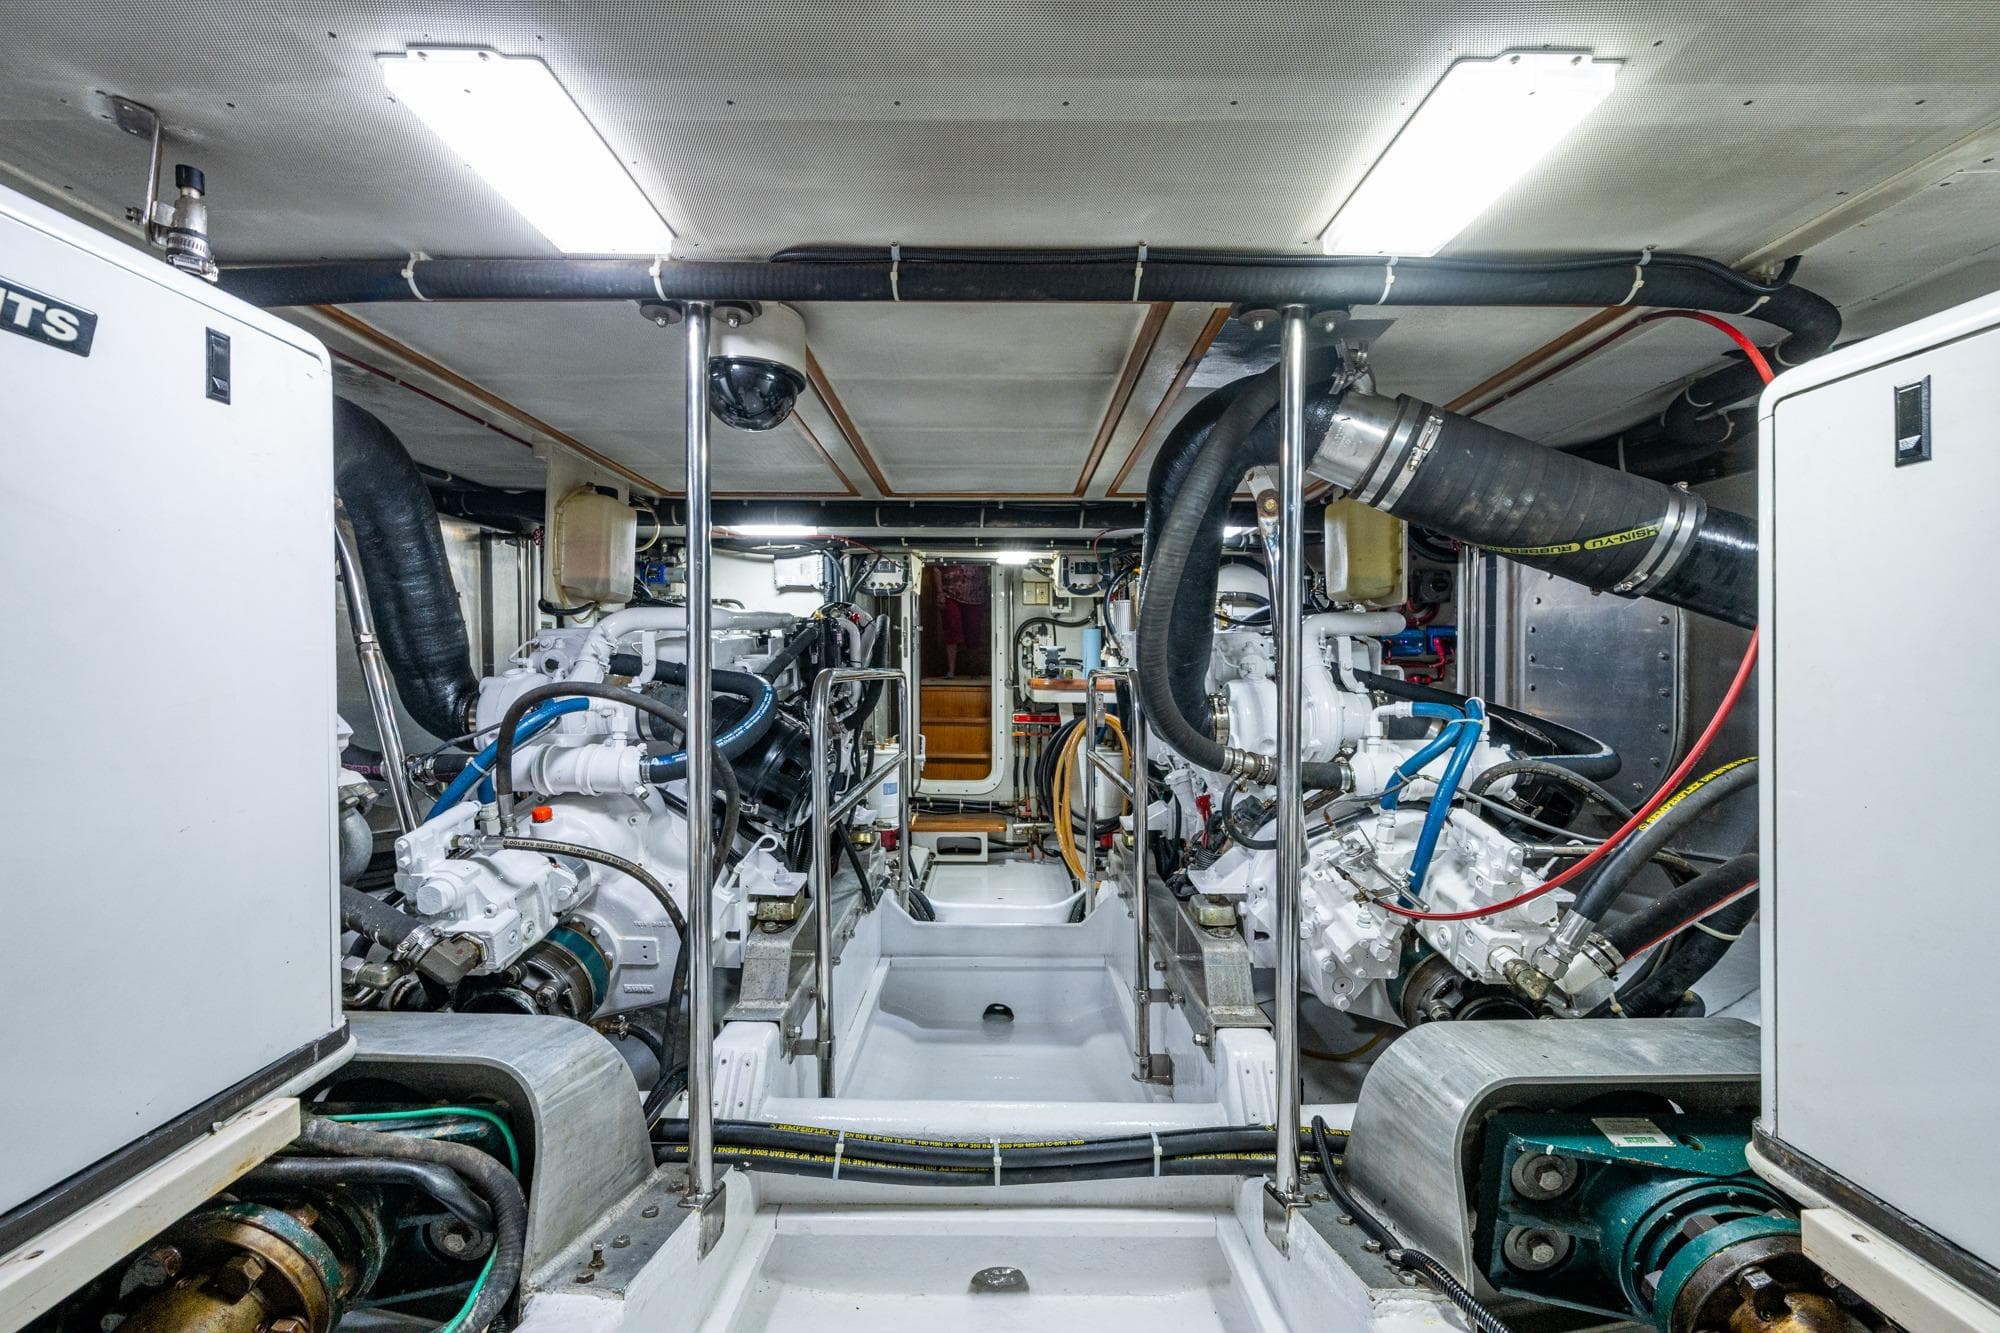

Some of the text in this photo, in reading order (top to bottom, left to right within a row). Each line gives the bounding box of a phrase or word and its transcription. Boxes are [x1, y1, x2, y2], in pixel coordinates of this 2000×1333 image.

[0, 288, 80, 342] TS
[1592, 527, 1660, 547] HSIN-YU
[1511, 544, 1572, 553] RUBBER
